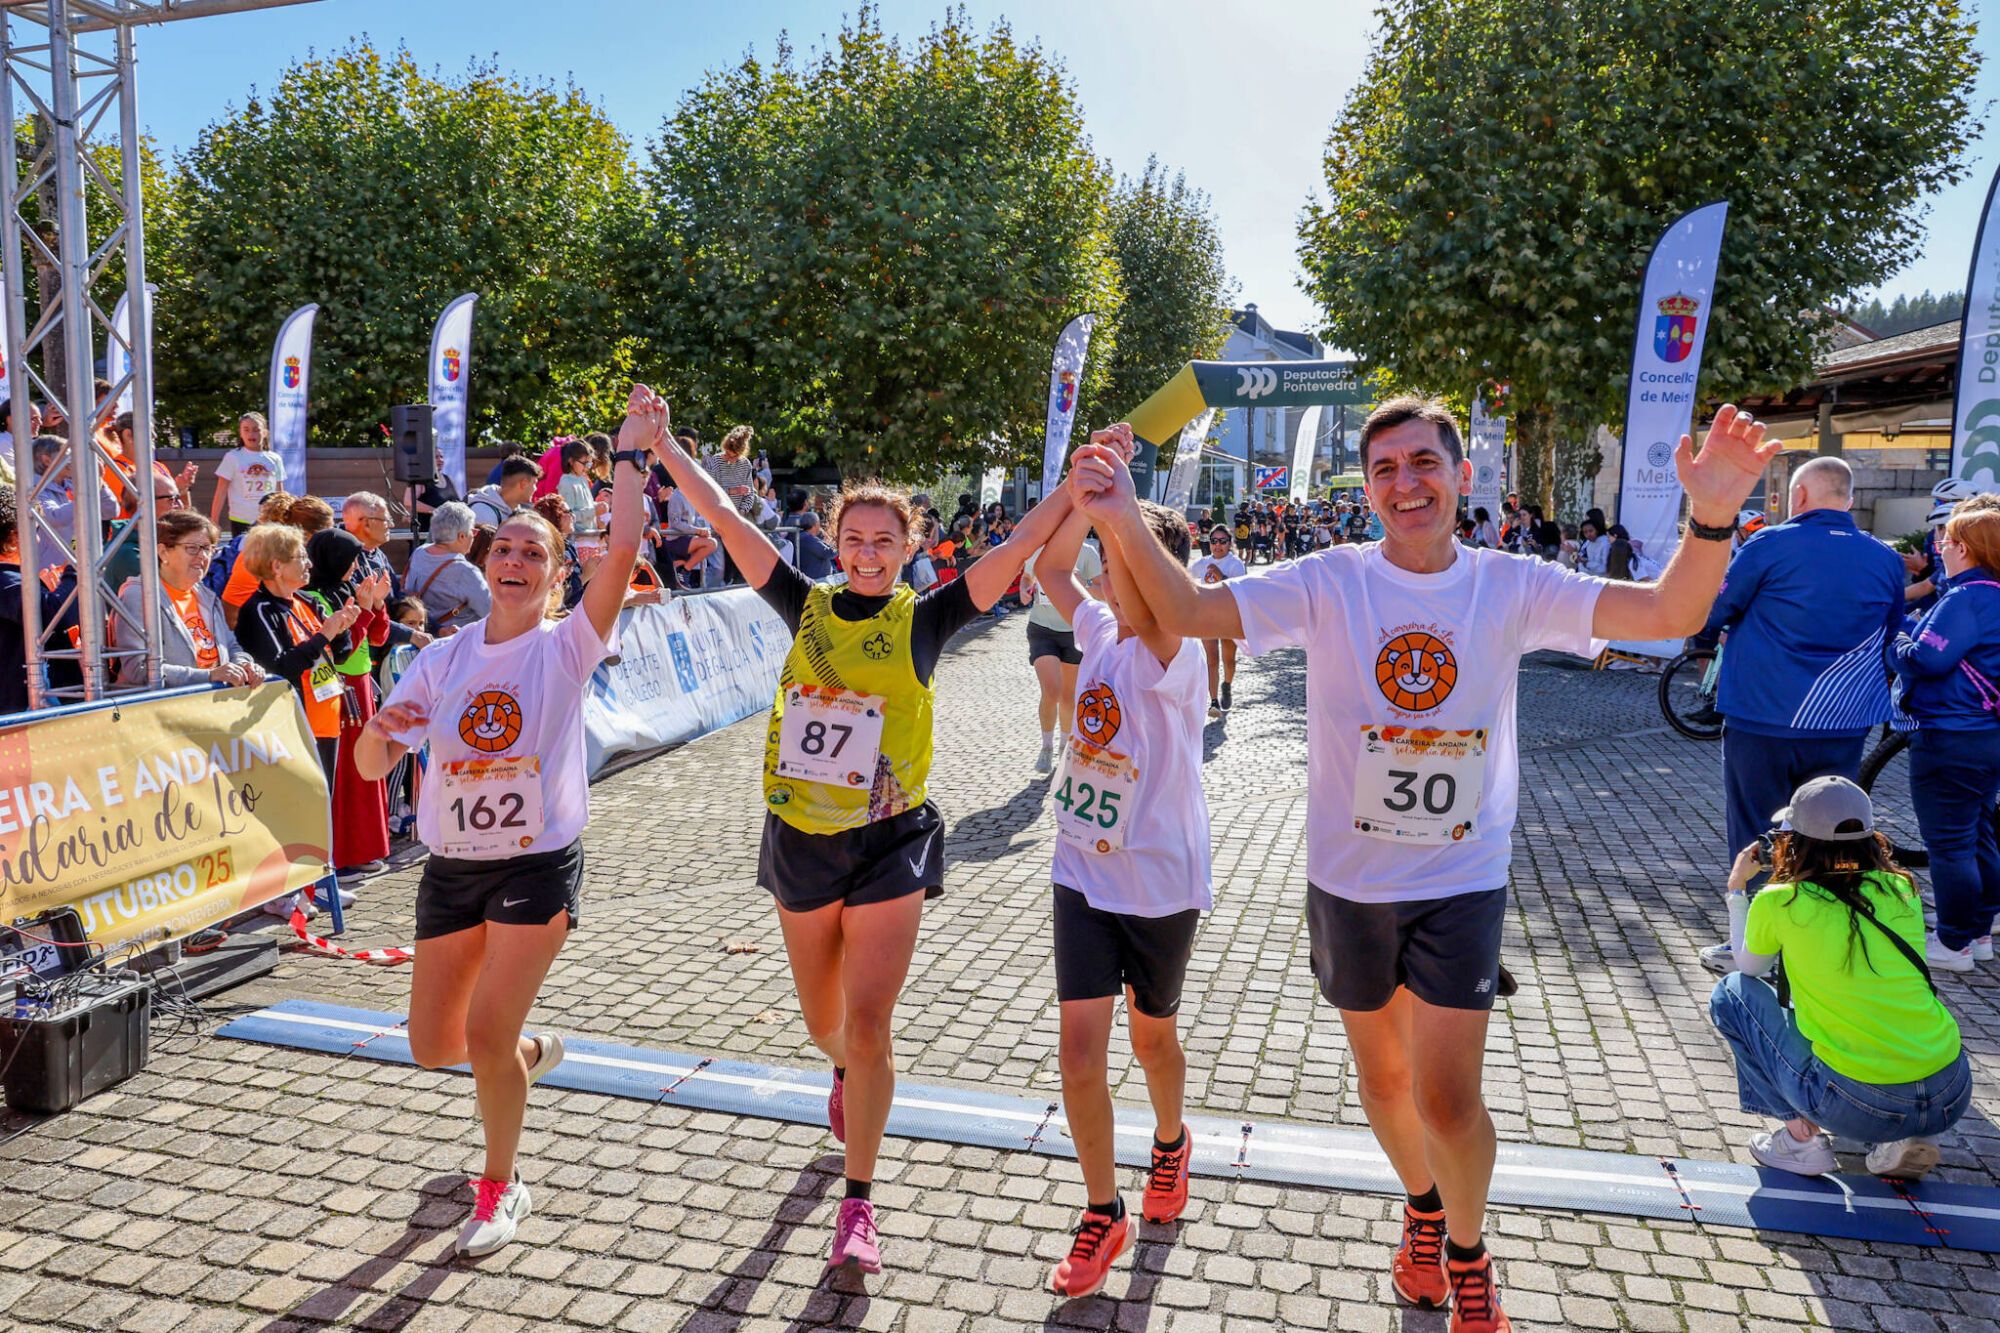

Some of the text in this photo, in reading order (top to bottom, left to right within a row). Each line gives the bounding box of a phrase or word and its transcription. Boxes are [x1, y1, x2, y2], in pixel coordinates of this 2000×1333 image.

[1283, 368, 1353, 382] Deputació
[1283, 380, 1357, 392] Pontevedra
[1640, 390, 1657, 402] de
[1637, 468, 1676, 484] Meis
[800, 720, 853, 758] 87
[97, 765, 124, 808] E
[134, 735, 293, 799] ANDAINA
[154, 779, 202, 842] de
[212, 771, 263, 840] Leo
[1055, 775, 1121, 829] 425
[1383, 769, 1457, 815] 30
[450, 793, 527, 832] 162
